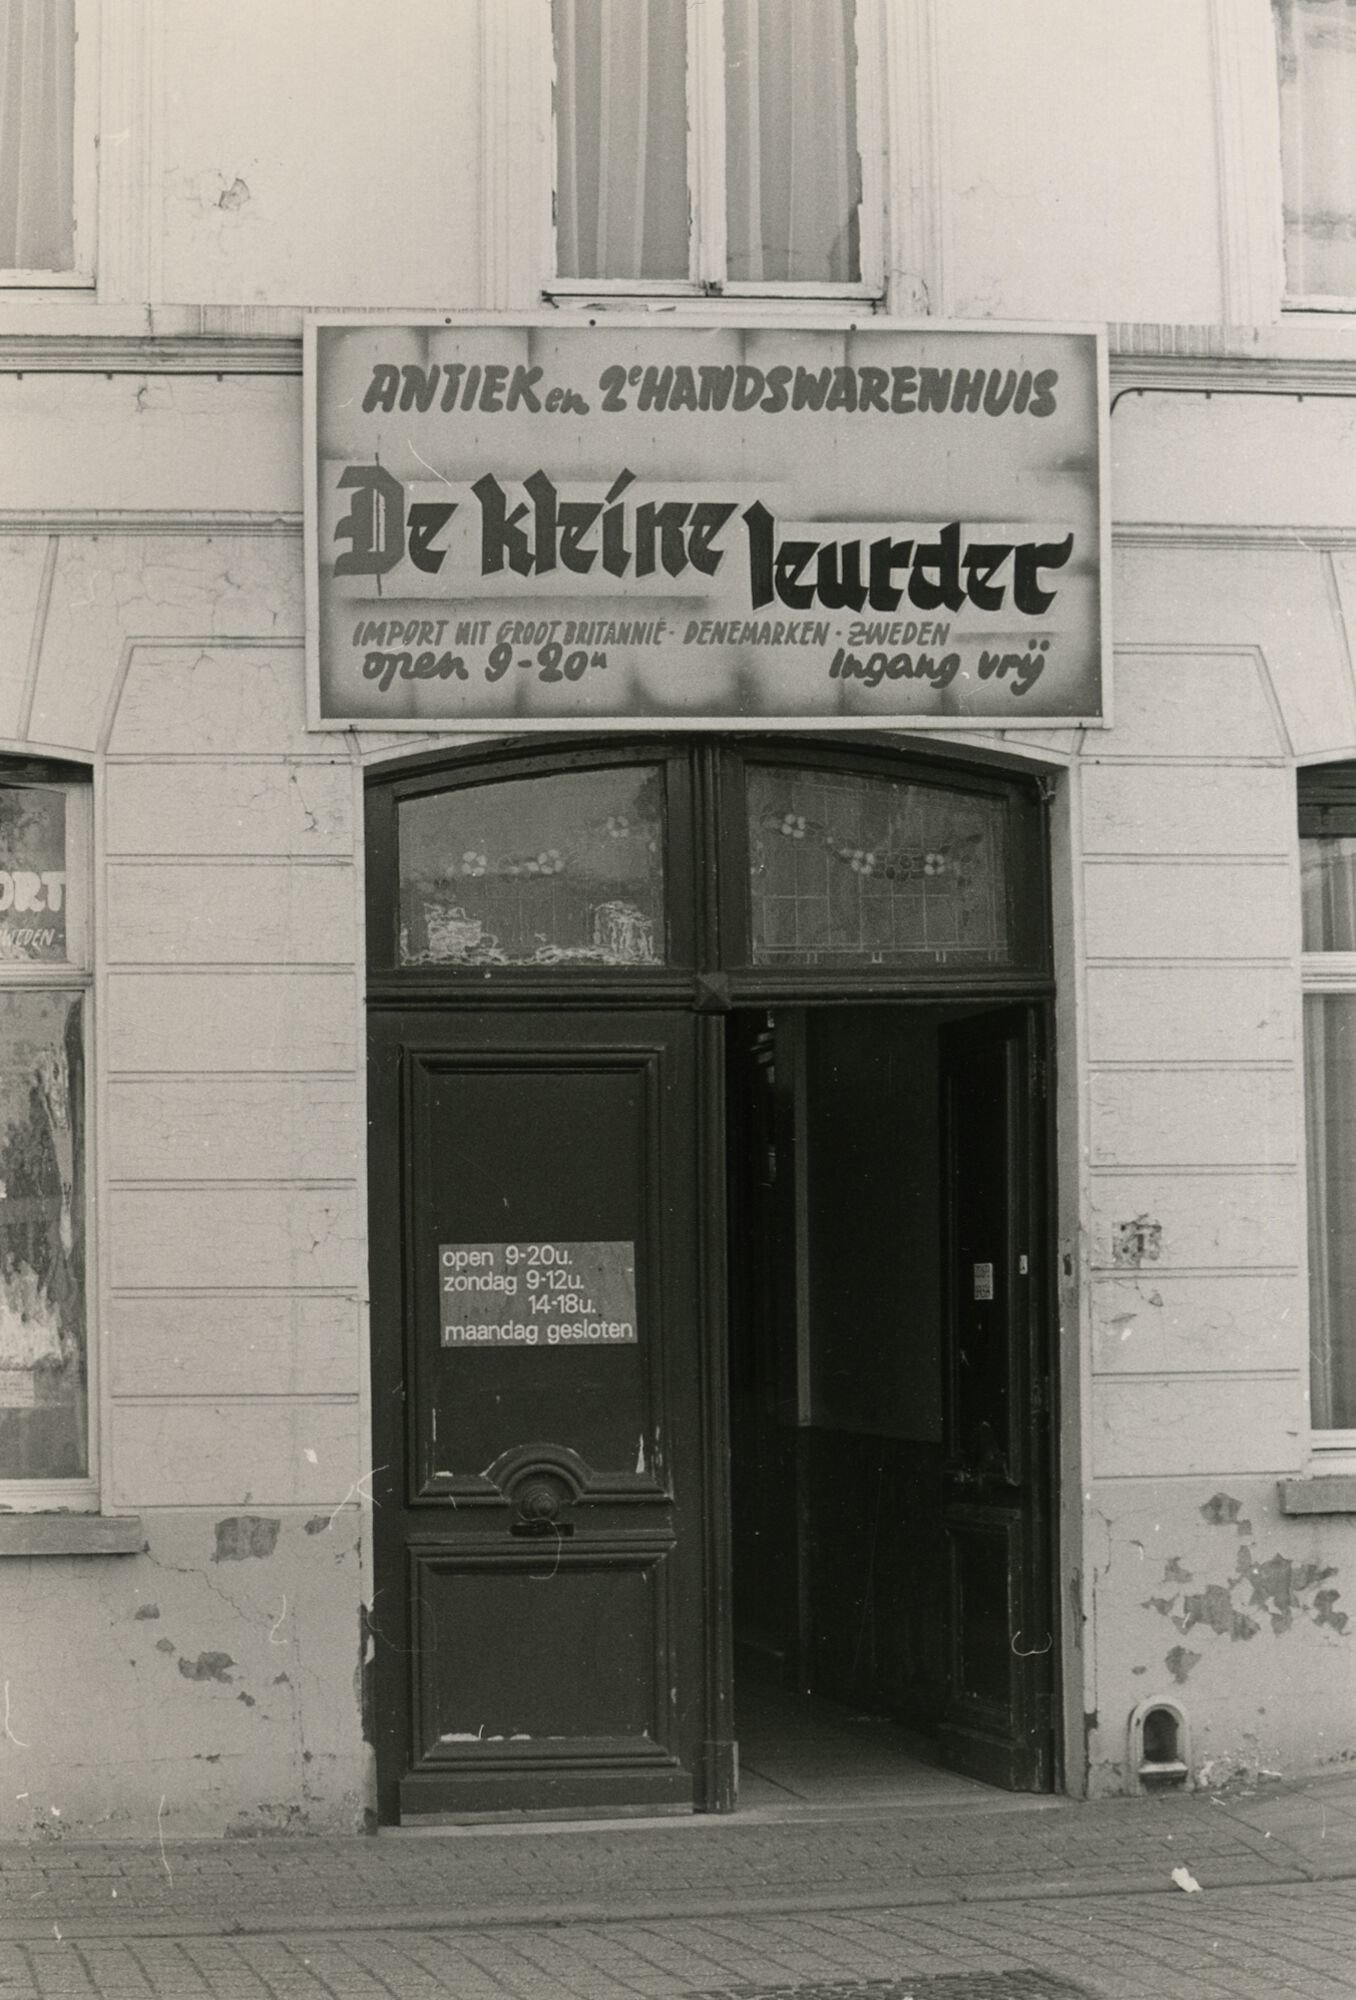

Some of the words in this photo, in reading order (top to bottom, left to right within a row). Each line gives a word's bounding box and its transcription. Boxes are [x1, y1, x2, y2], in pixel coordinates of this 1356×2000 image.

[361, 363, 544, 414] ANTIEK
[544, 387, 590, 416] en
[333, 464, 459, 579] De
[470, 467, 740, 580] kleine
[741, 499, 1075, 615] leurder
[352, 620, 449, 646] IMPORT
[496, 620, 562, 646] GROOT
[683, 620, 831, 647] DENEMARKEN
[847, 621, 951, 647] ZWEDEN
[362, 650, 470, 693] open
[828, 648, 961, 690] Ingang
[442, 1251, 494, 1271] open
[505, 1245, 573, 1266] 9-20u.
[443, 1272, 518, 1295] zondag
[525, 1269, 585, 1290] 9-12u.
[527, 1293, 597, 1315] 14-18u.
[444, 1320, 539, 1345] maandag
[546, 1318, 633, 1345] gesloten
